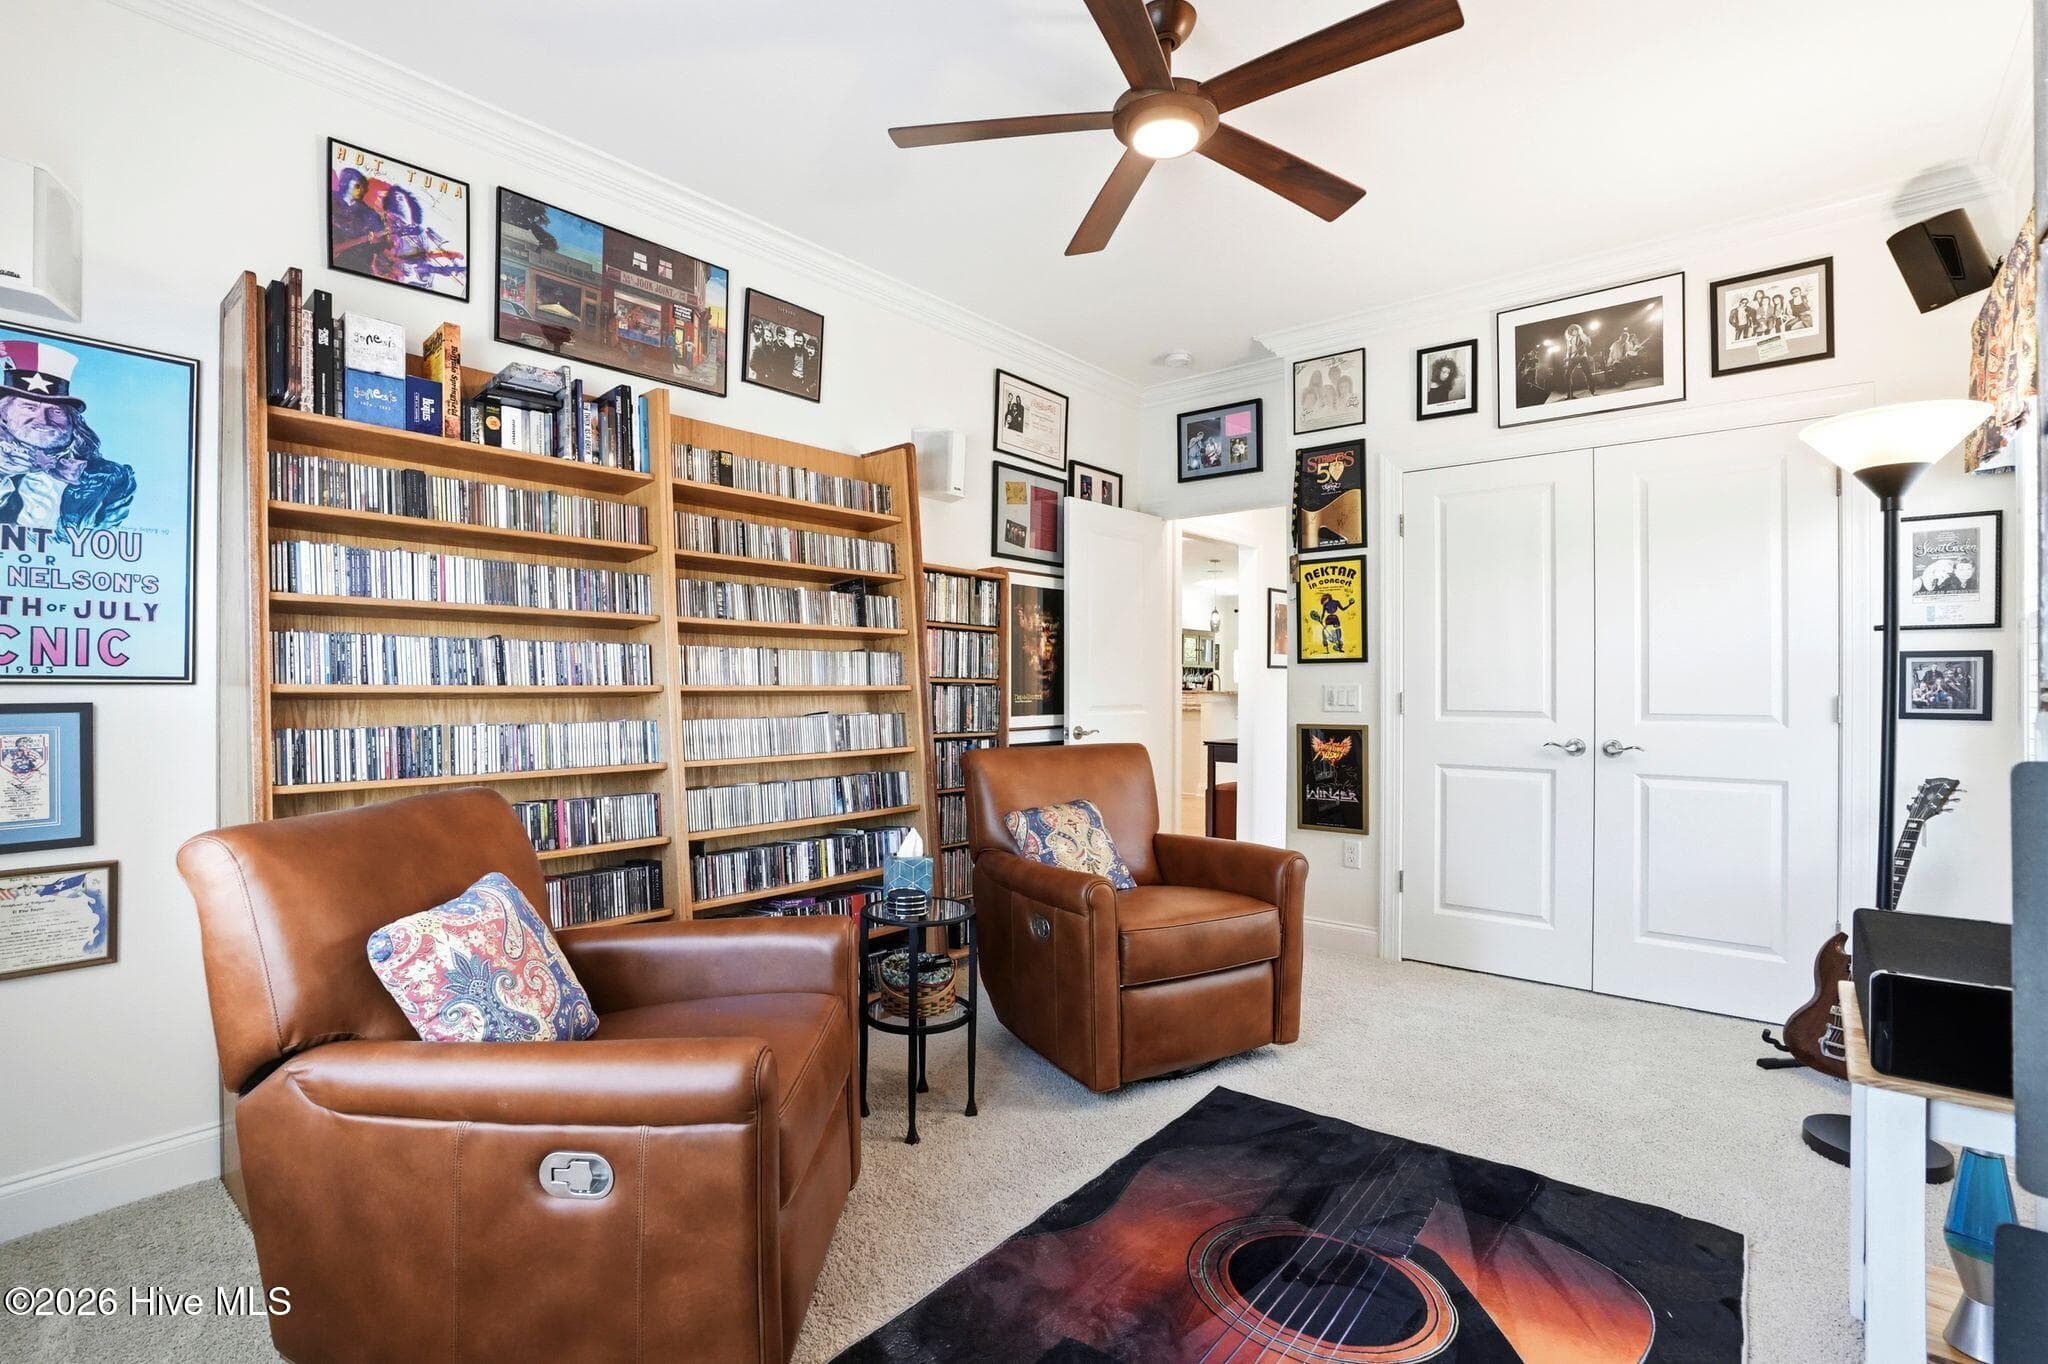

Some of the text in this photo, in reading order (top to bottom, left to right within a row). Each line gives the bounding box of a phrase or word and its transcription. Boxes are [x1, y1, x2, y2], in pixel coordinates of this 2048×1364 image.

[336, 147, 463, 199] HOT TUNA
[66, 527, 142, 562] YOU
[8, 565, 160, 594] NELSON'S
[47, 603, 67, 612] OF
[74, 600, 159, 622] JULY
[5, 665, 54, 674] 1983
